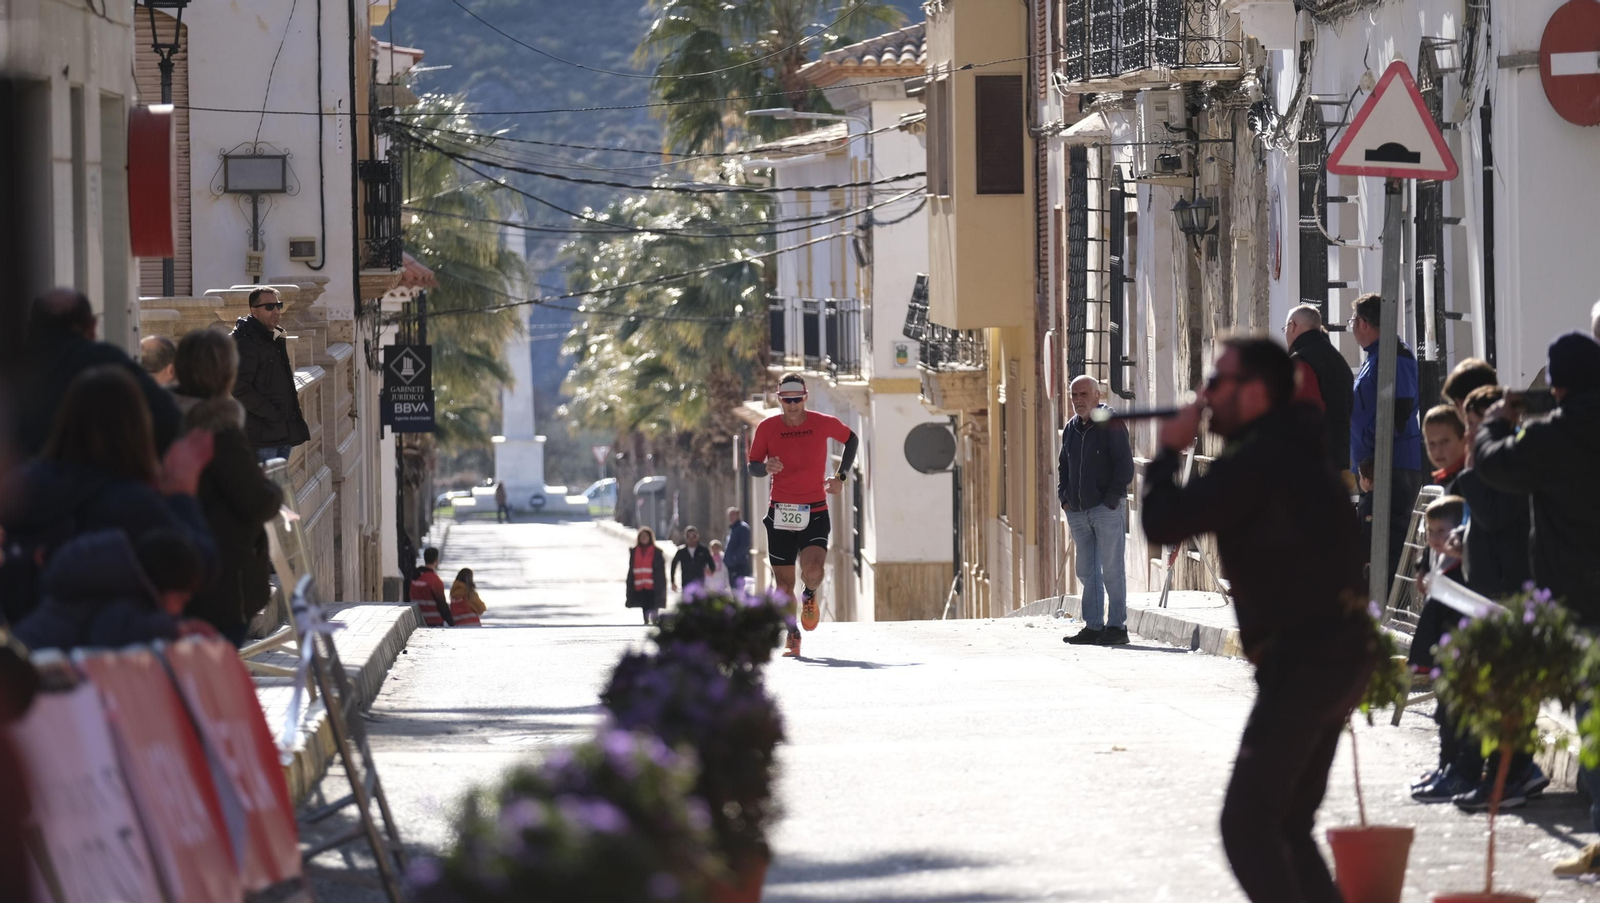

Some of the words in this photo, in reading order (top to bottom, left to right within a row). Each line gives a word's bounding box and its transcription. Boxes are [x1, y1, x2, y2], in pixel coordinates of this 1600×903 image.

[391, 392, 424, 402] JURÍDICO
[394, 402, 429, 414] BBVA
[781, 512, 802, 524] 326
